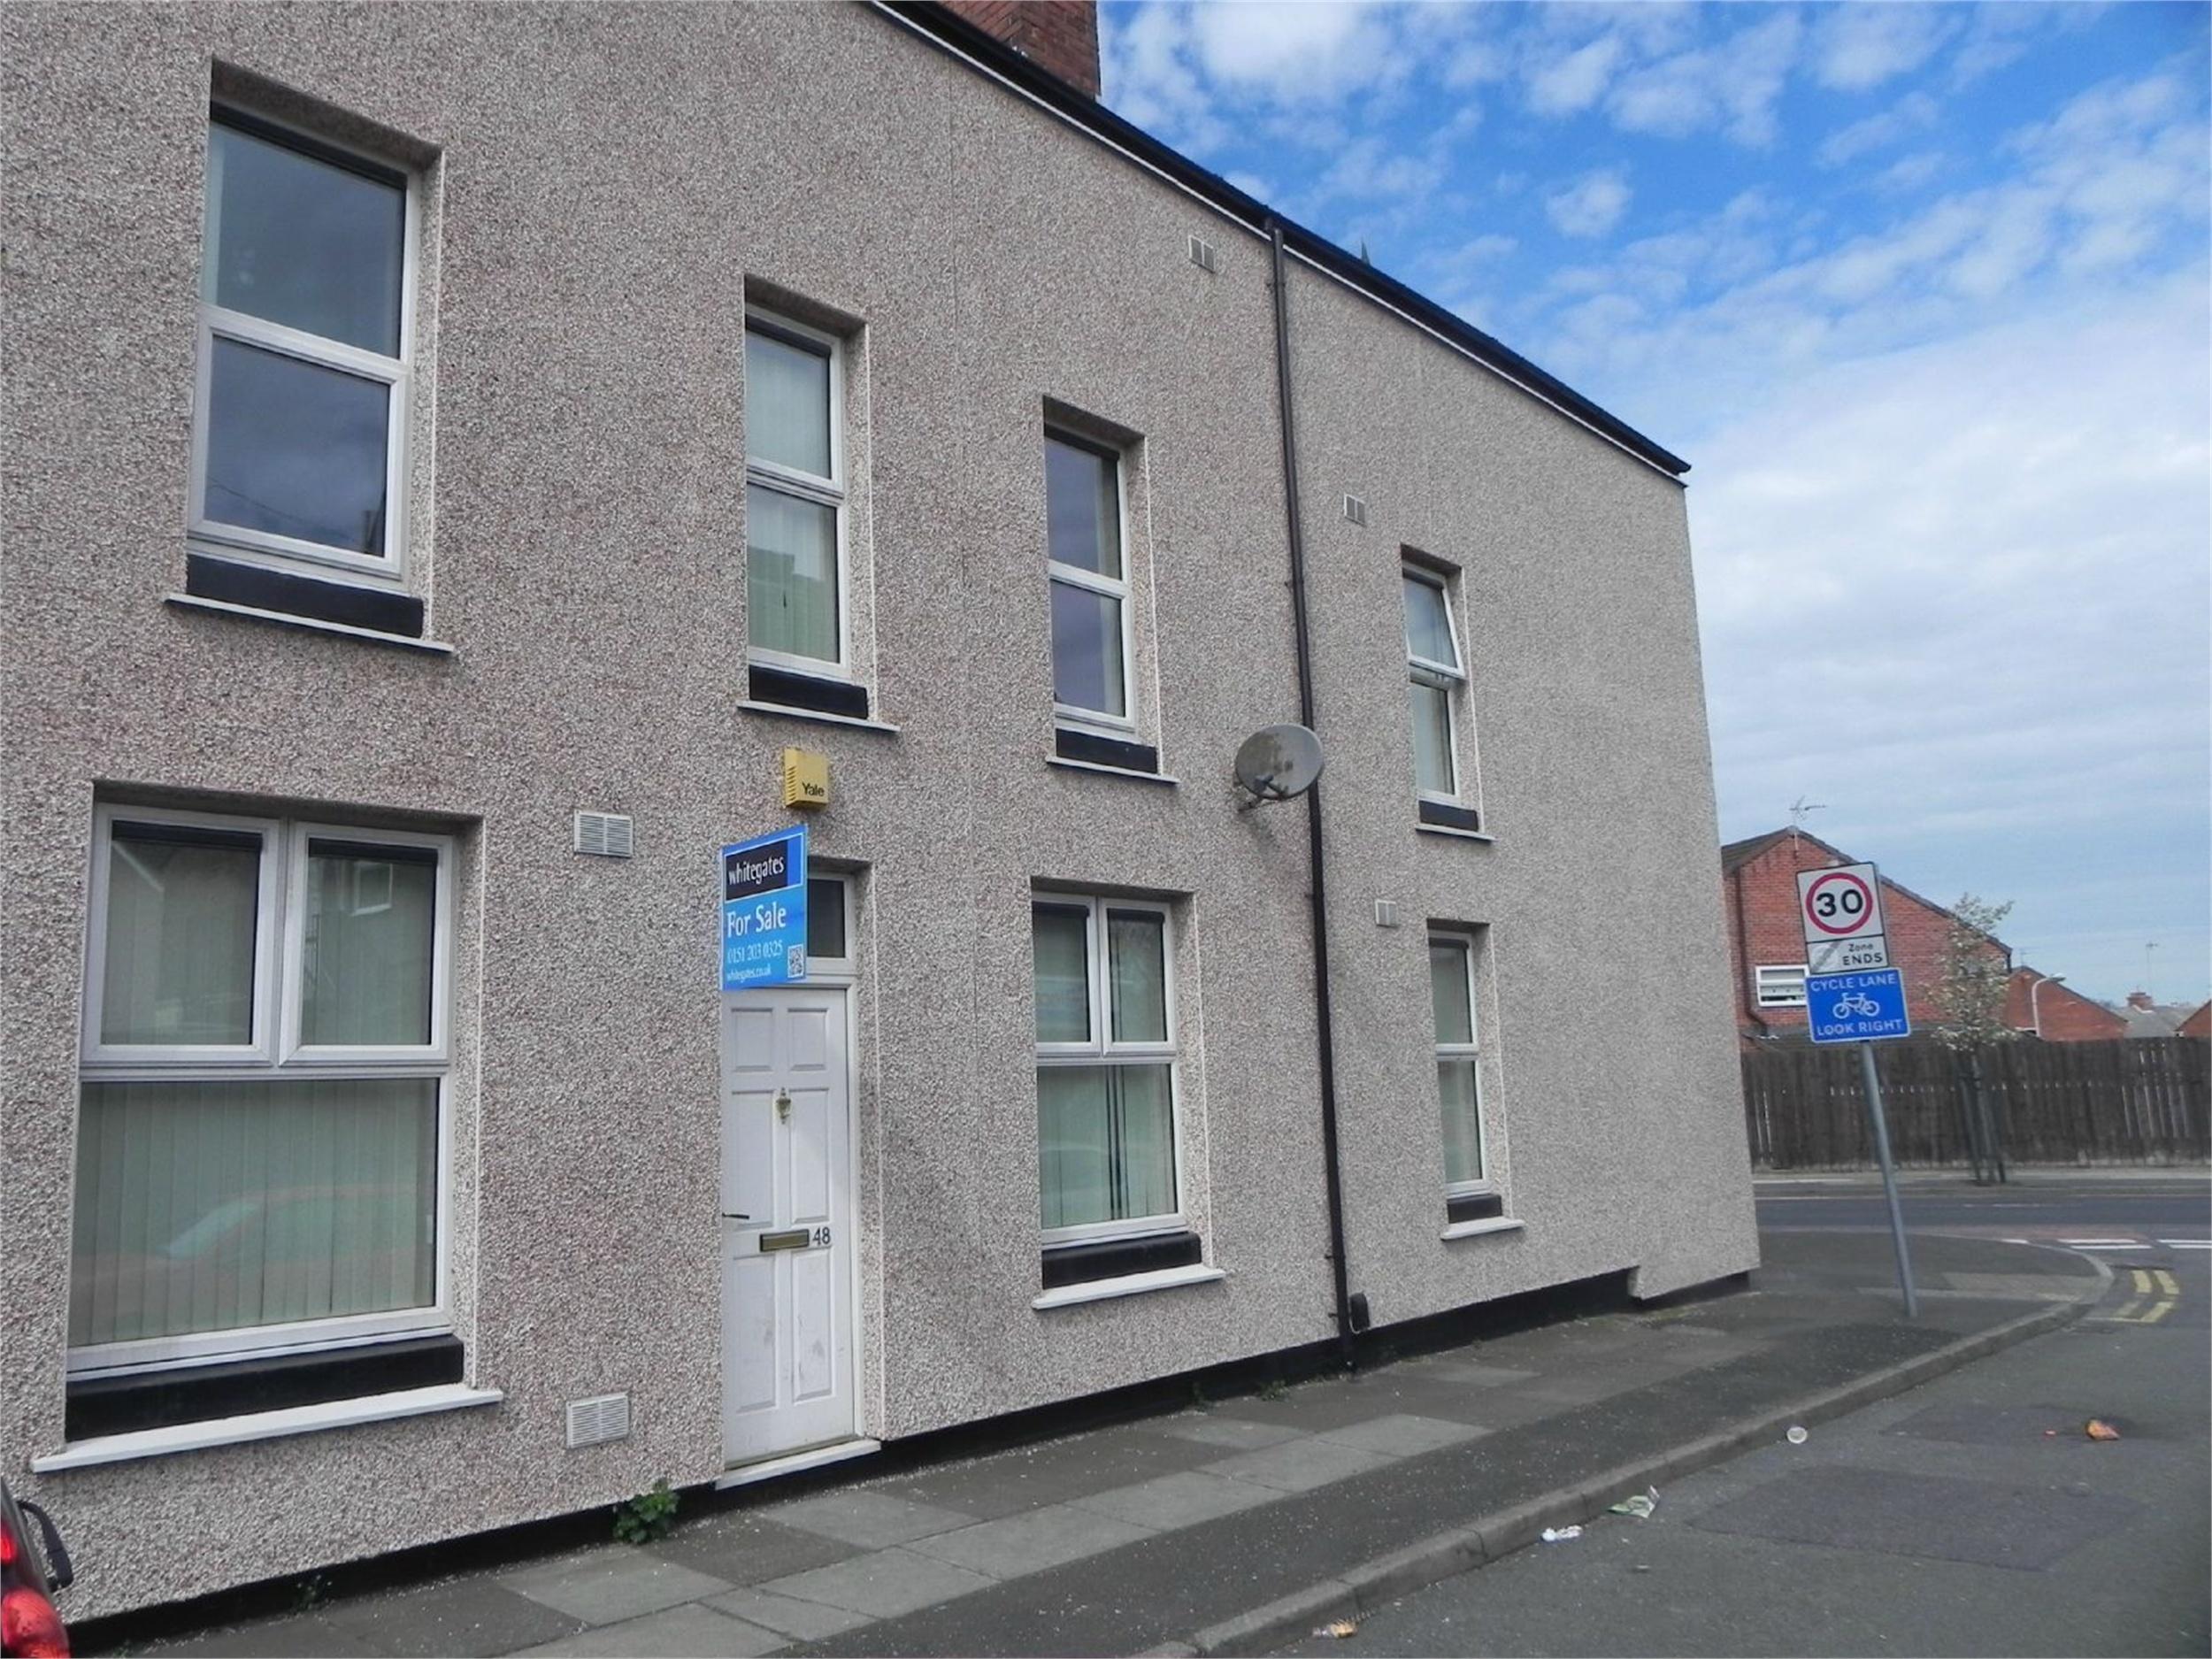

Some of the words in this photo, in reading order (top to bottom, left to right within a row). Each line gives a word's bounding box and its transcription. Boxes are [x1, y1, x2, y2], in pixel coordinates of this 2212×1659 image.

[802, 782, 825, 796] Yale
[728, 856, 785, 886] whitegates
[1816, 889, 1863, 917] 30
[727, 910, 751, 938] For
[756, 902, 787, 932] Sale
[1848, 942, 1874, 952] Zone
[1843, 952, 1883, 965] ENDS
[1810, 979, 1856, 992] CYCLE
[1858, 973, 1896, 987] LANE
[1816, 1022, 1855, 1036] LOOK
[1859, 1018, 1902, 1033] RIGHT
[812, 1226, 831, 1245] 48
